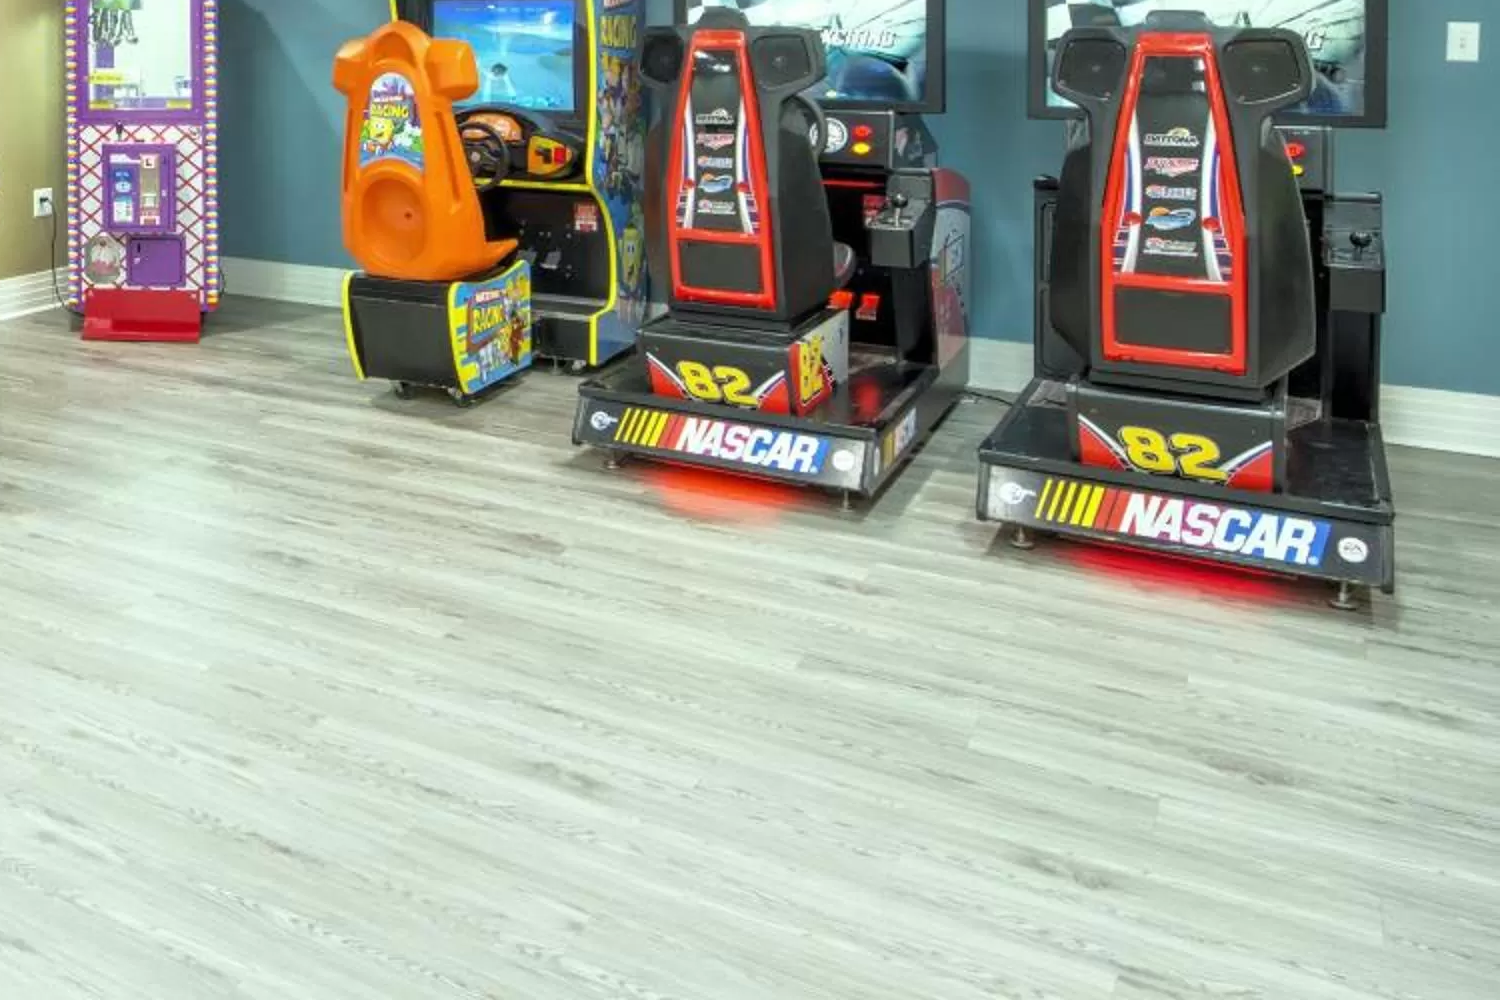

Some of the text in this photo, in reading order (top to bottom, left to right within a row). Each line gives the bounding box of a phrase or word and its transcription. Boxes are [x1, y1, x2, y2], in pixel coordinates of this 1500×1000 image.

[676, 359, 760, 409] 82
[675, 418, 818, 473] NASCAR
[1118, 425, 1229, 482] 82
[1119, 492, 1315, 564] NASCAR
